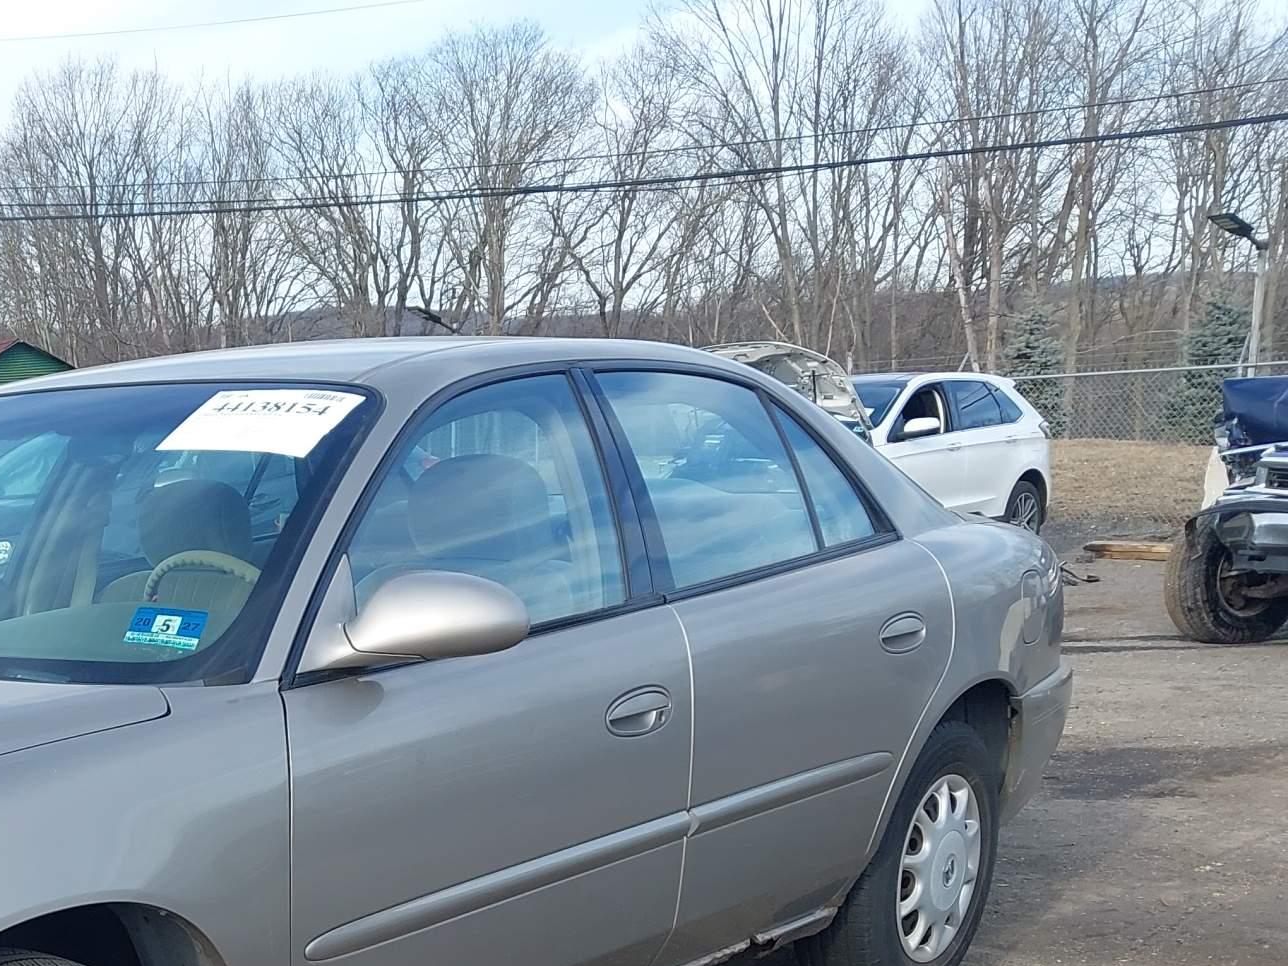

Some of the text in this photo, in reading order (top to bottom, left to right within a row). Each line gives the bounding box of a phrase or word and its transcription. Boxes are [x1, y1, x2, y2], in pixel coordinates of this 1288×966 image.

[212, 401, 331, 416] 44138154
[134, 617, 200, 632] 20 5 27
